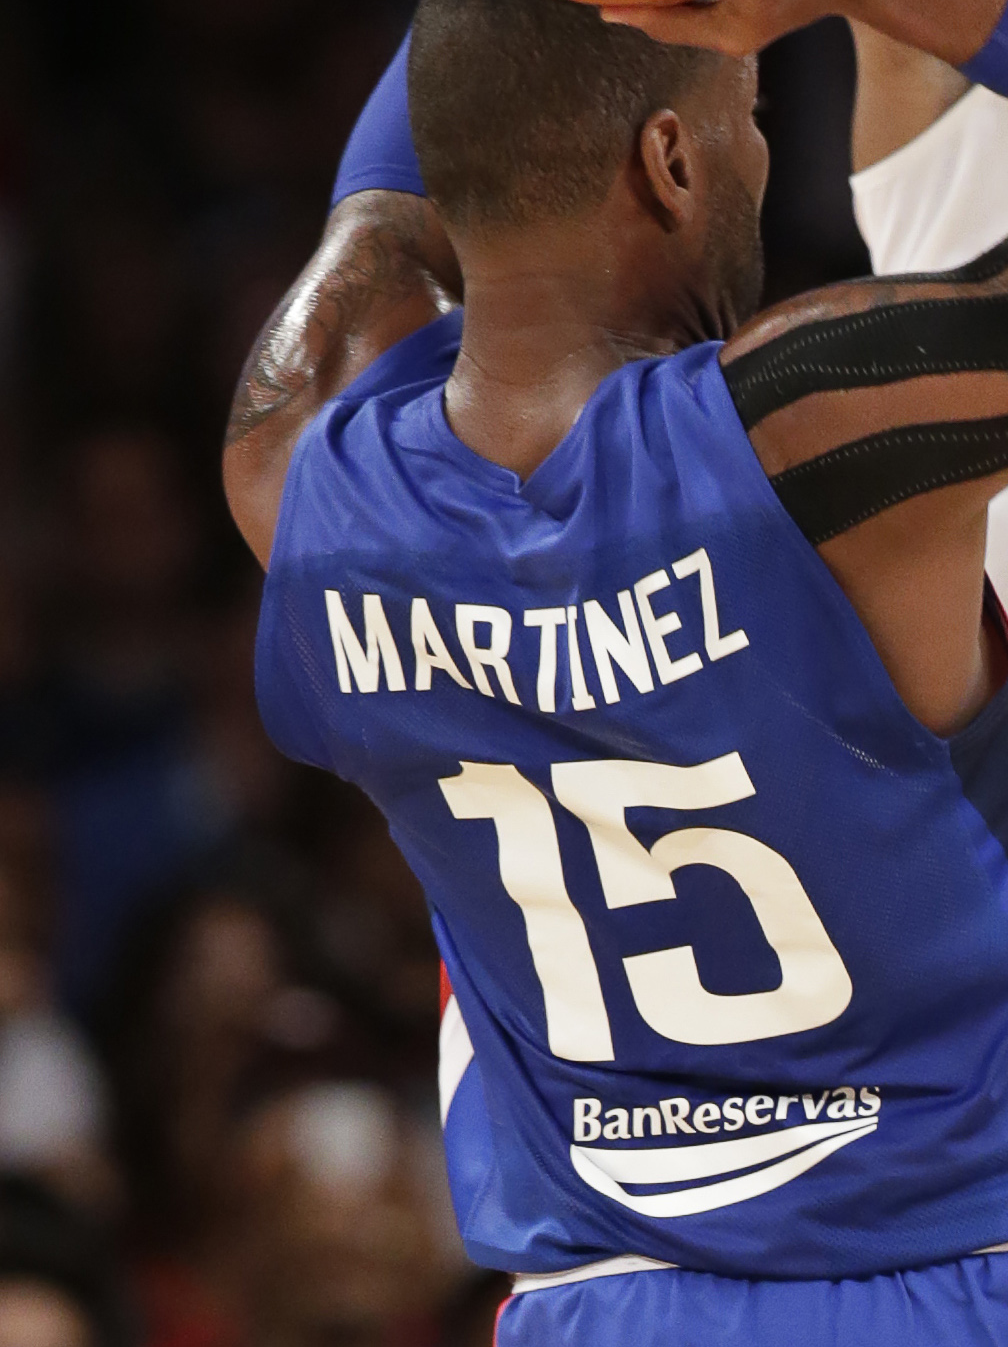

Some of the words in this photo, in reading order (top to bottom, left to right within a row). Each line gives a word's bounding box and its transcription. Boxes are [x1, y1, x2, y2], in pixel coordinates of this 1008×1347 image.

[324, 548, 749, 713] MARTINEZ
[437, 751, 852, 1062] 15
[573, 1086, 881, 1142] BanReservas
